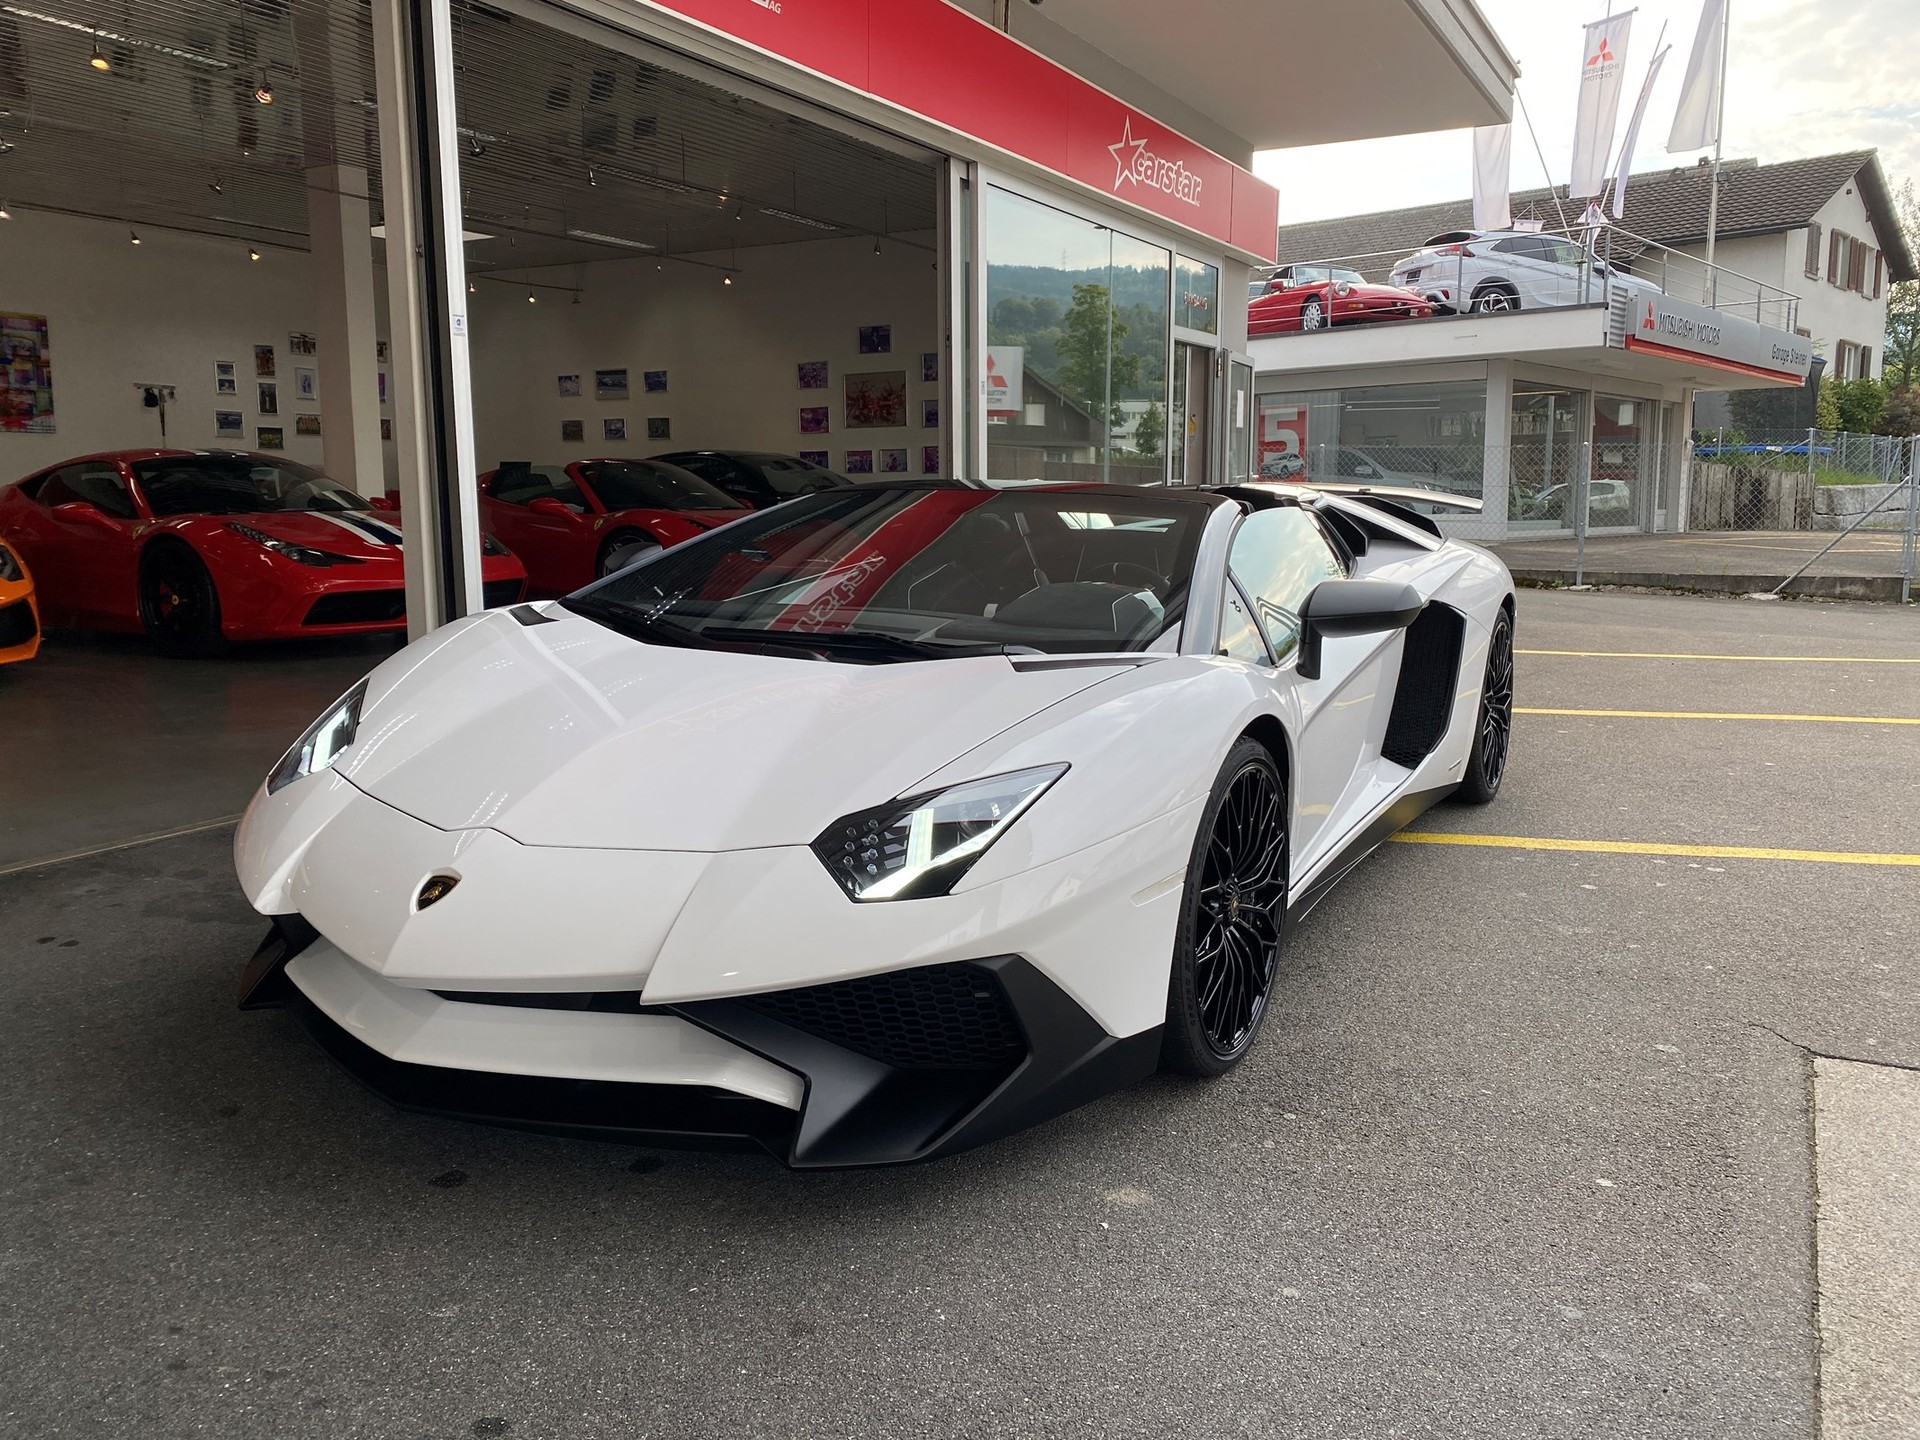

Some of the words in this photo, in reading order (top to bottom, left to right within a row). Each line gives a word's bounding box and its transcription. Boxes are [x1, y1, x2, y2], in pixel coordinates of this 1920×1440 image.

[768, 0, 781, 15] AG
[1584, 71, 1613, 83] MOTORS
[1133, 148, 1203, 205] carstar
[1657, 312, 1696, 338] MITSUBISHI
[1696, 322, 1721, 346] MOTORS
[1771, 343, 1790, 365] Garage
[1264, 407, 1300, 465] 5
